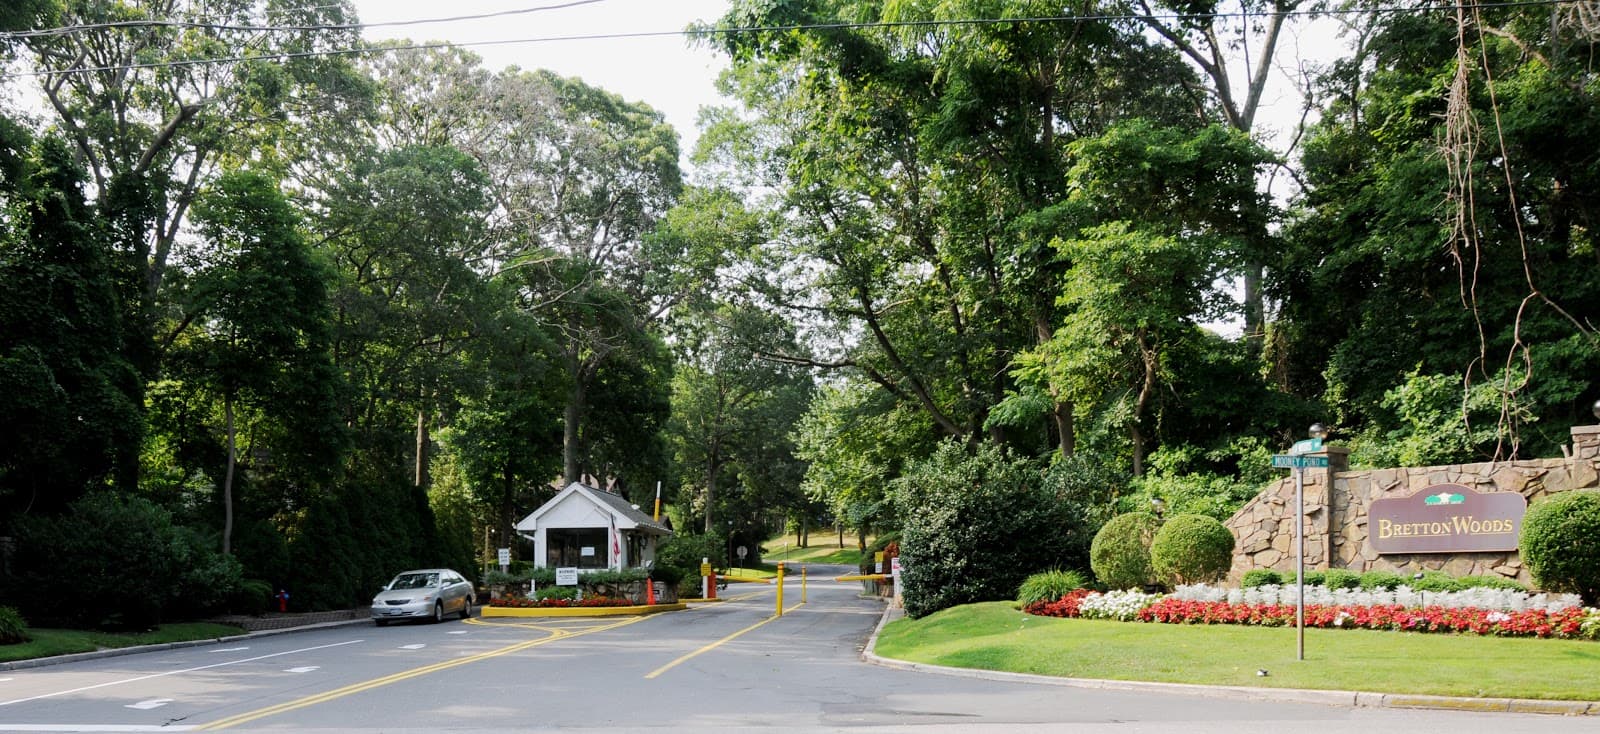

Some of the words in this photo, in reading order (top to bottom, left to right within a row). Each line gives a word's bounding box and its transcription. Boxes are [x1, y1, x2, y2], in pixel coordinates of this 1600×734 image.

[1275, 457, 1300, 466] MOONEY
[1303, 457, 1320, 466] POND
[1378, 518, 1452, 539] BRETTON
[1451, 516, 1513, 535] WOODS
